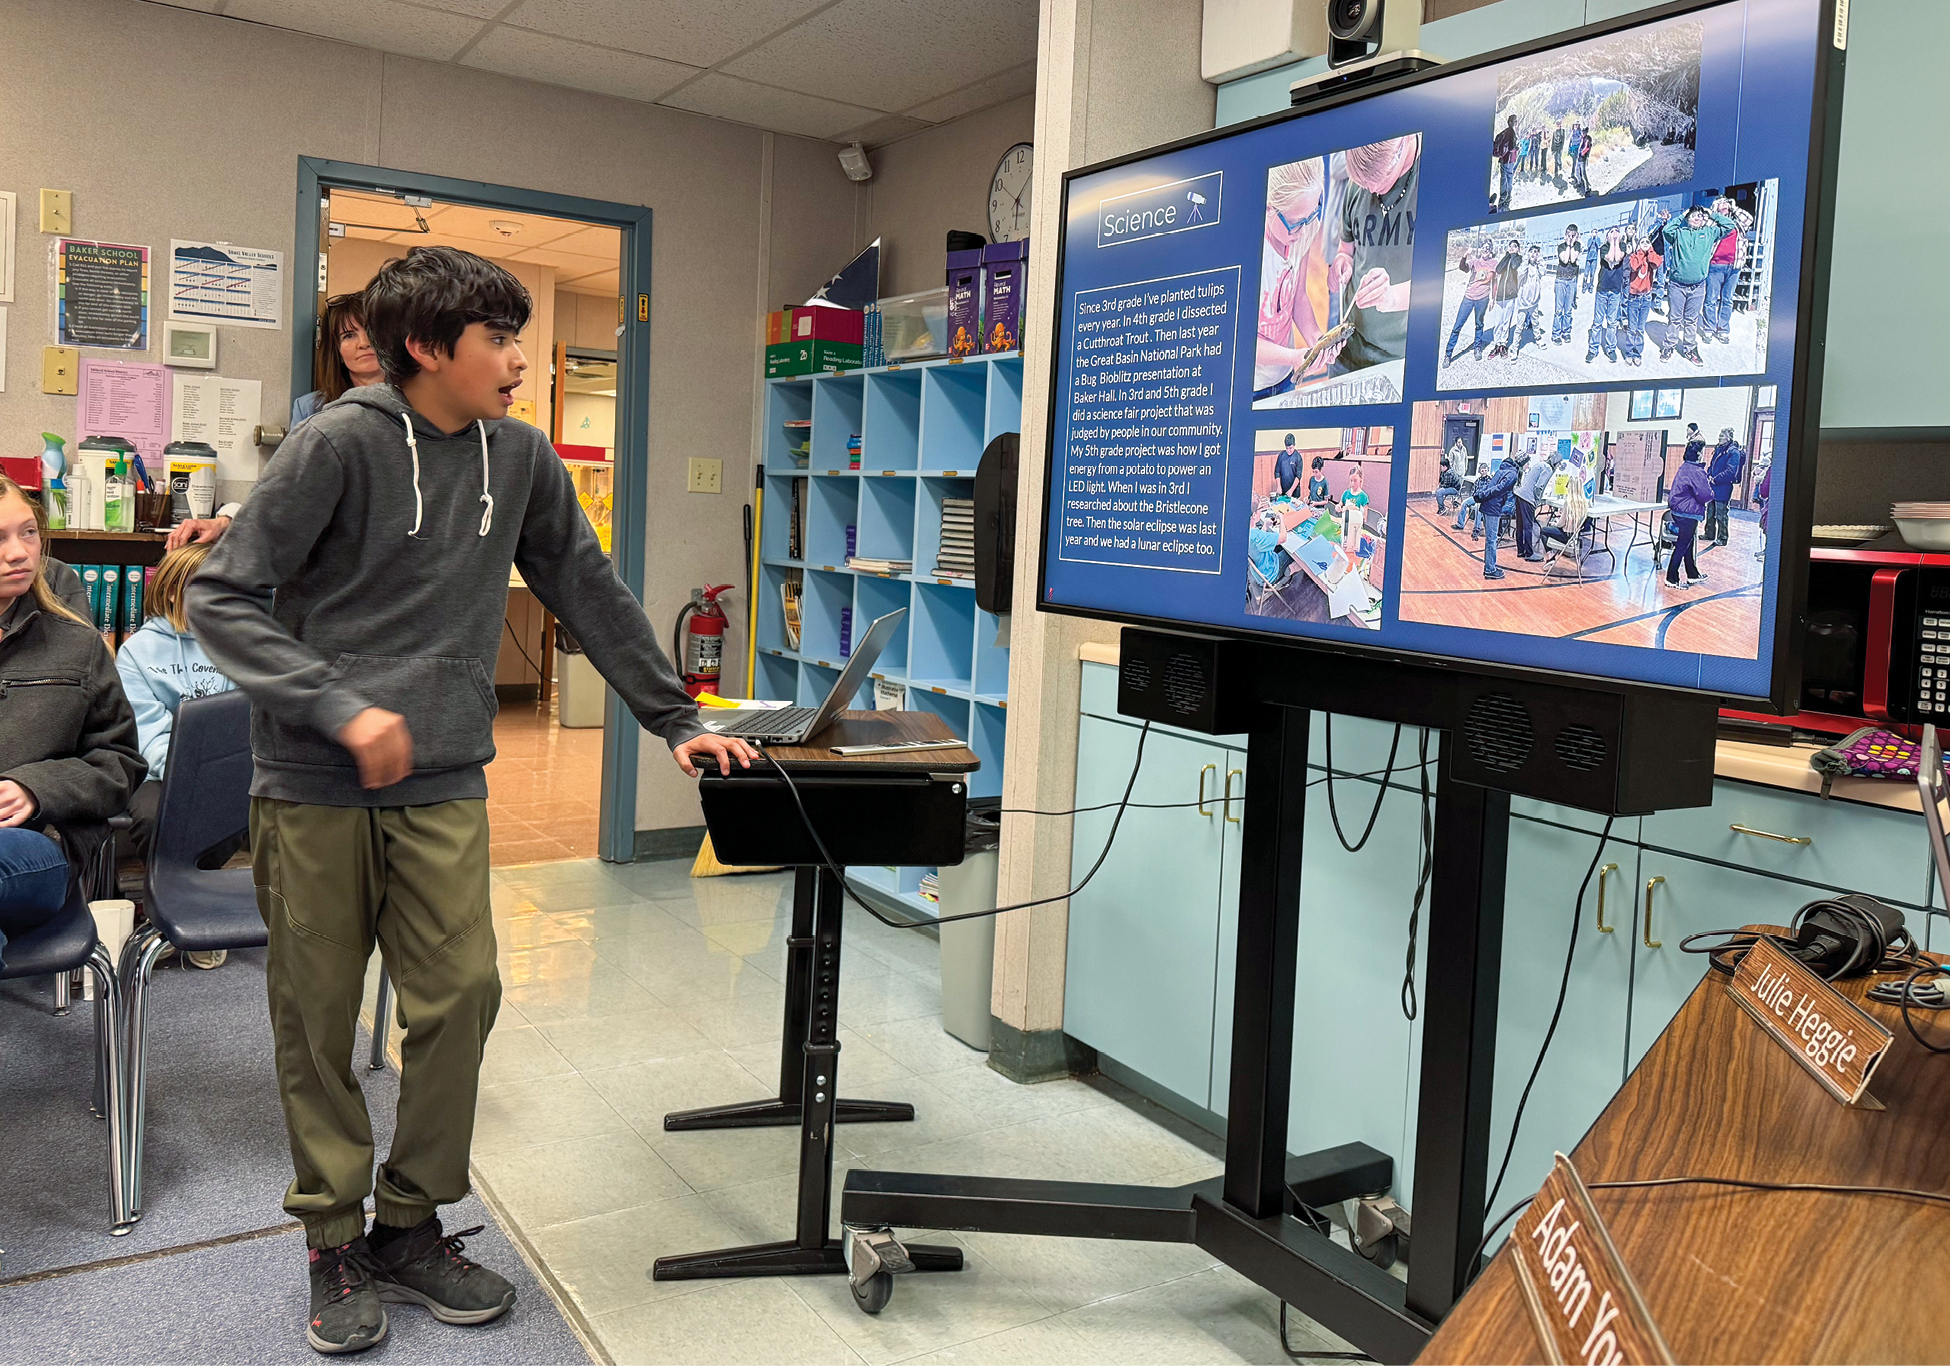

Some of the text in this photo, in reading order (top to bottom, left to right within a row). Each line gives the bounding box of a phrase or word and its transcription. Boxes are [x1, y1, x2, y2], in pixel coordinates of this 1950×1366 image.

[1016, 150, 1024, 164] 12
[1004, 160, 1010, 173] 11
[994, 178, 1003, 192] 10
[992, 200, 998, 213] 9
[995, 220, 1000, 233] 8
[1103, 205, 1177, 237] Science
[1352, 210, 1416, 247] ARMY
[69, 255, 118, 264] EVACUATION
[70, 246, 138, 259] BAKER SCHOOL
[956, 291, 971, 300] MATH
[994, 286, 1011, 295] MATH
[1079, 302, 1100, 314] Since
[1102, 297, 1116, 311] 3rd
[1117, 294, 1142, 312] grade
[1160, 286, 1196, 304] planted
[1197, 282, 1224, 298] tulips
[1078, 300, 1227, 332] every year. In 4th grade I dissected
[1077, 341, 1082, 350] a
[1083, 334, 1124, 349] Cutthroat
[1154, 328, 1177, 341] Then
[1179, 325, 1196, 339] last
[1197, 325, 1219, 339] year
[1076, 341, 1222, 368] the Great Basin National Park had
[1074, 364, 1202, 387] a Bug Bioblitz presentation at
[1074, 382, 1213, 404] Baker Hall. In 3rd and 5th grade I
[1072, 403, 1214, 421] did a science fair project that was
[1071, 422, 1222, 441] judged by people in our community.
[1070, 442, 1221, 458] My 5th grade project was how I got
[1069, 462, 1211, 477] energy from a potato to power an
[1068, 480, 1190, 495] LED light. When I was in 3rd I
[1067, 498, 1208, 514] researched about the Bristlecone
[1066, 516, 1217, 535] tree. Then the solar eclipse was last
[1065, 534, 1215, 555] year and we had a lunar eclipse too.
[170, 663, 187, 674] Th
[1750, 964, 1858, 1073] Julie Heggie
[1532, 1198, 1623, 1366] Adam Yo
